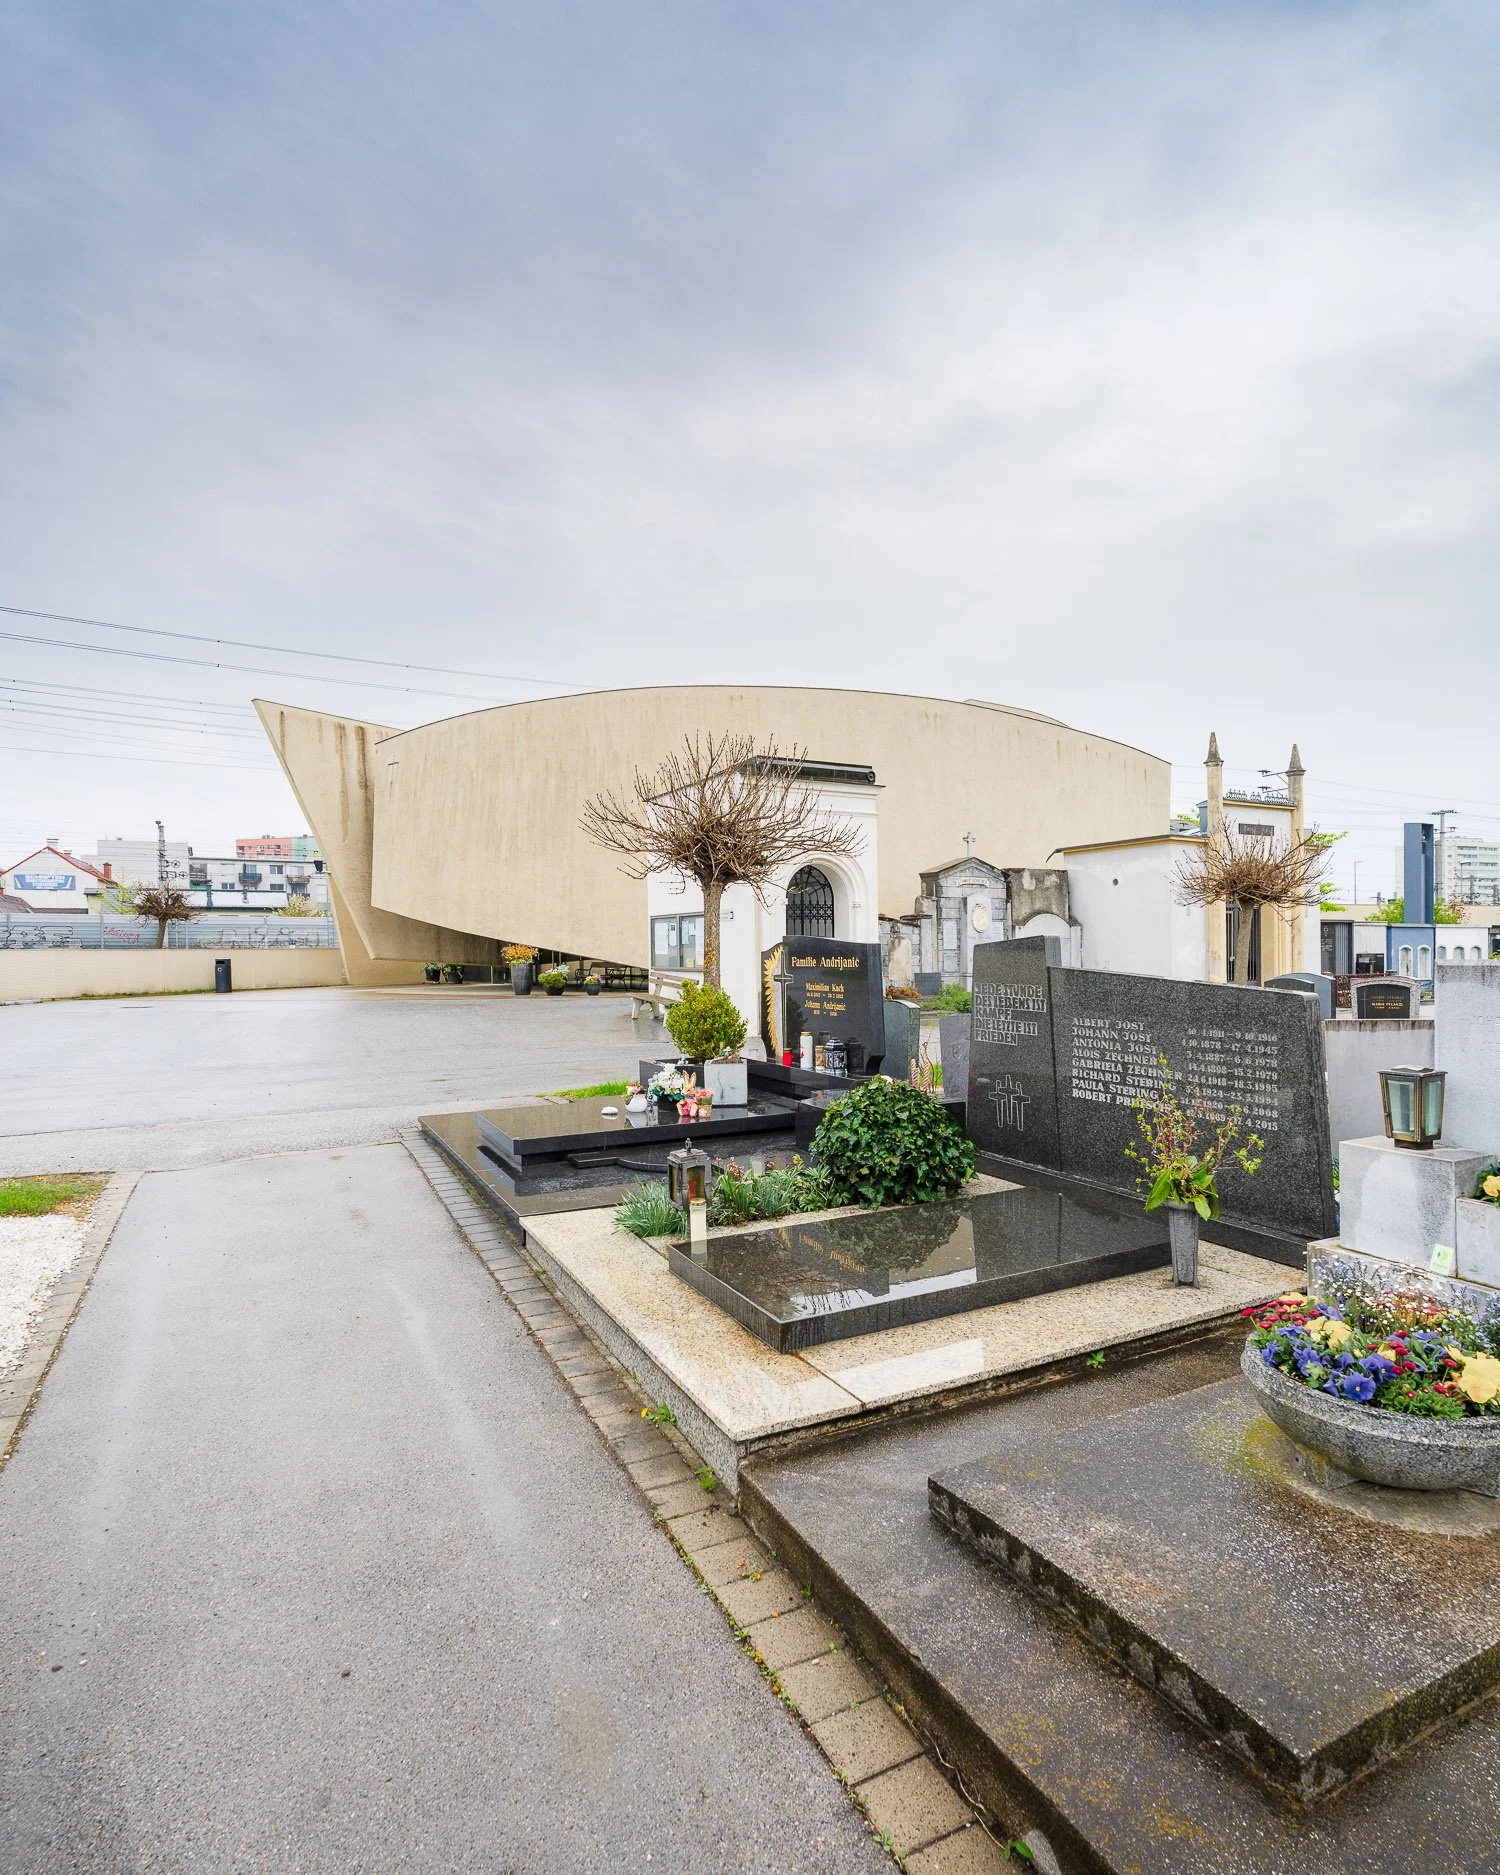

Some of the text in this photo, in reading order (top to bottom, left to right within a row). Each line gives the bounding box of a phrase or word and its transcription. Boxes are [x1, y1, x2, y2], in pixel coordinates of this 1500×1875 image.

[791, 956, 860, 971] Familie Andrijanić
[974, 983, 1002, 997] JEDE
[975, 995, 1046, 1012] DES LEBENS IST
[975, 1006, 1012, 1021] KAMPF
[975, 1017, 1038, 1036] DIE LETZTE IST
[1072, 1017, 1145, 1031] ALBERT JOST
[975, 1028, 1018, 1046] FRIEDEN
[1072, 1026, 1152, 1042] JOHANN JOST
[1072, 1038, 1157, 1054] ANTONIA JOST
[1072, 1048, 1158, 1066] ALOIS ZECHNER
[1072, 1058, 1182, 1080] GABRIELA ZECHNER
[1072, 1068, 1177, 1090] RICHARD STERING
[1072, 1078, 1158, 1100] PAULA STERING
[1072, 1088, 1112, 1103] ROBERT
